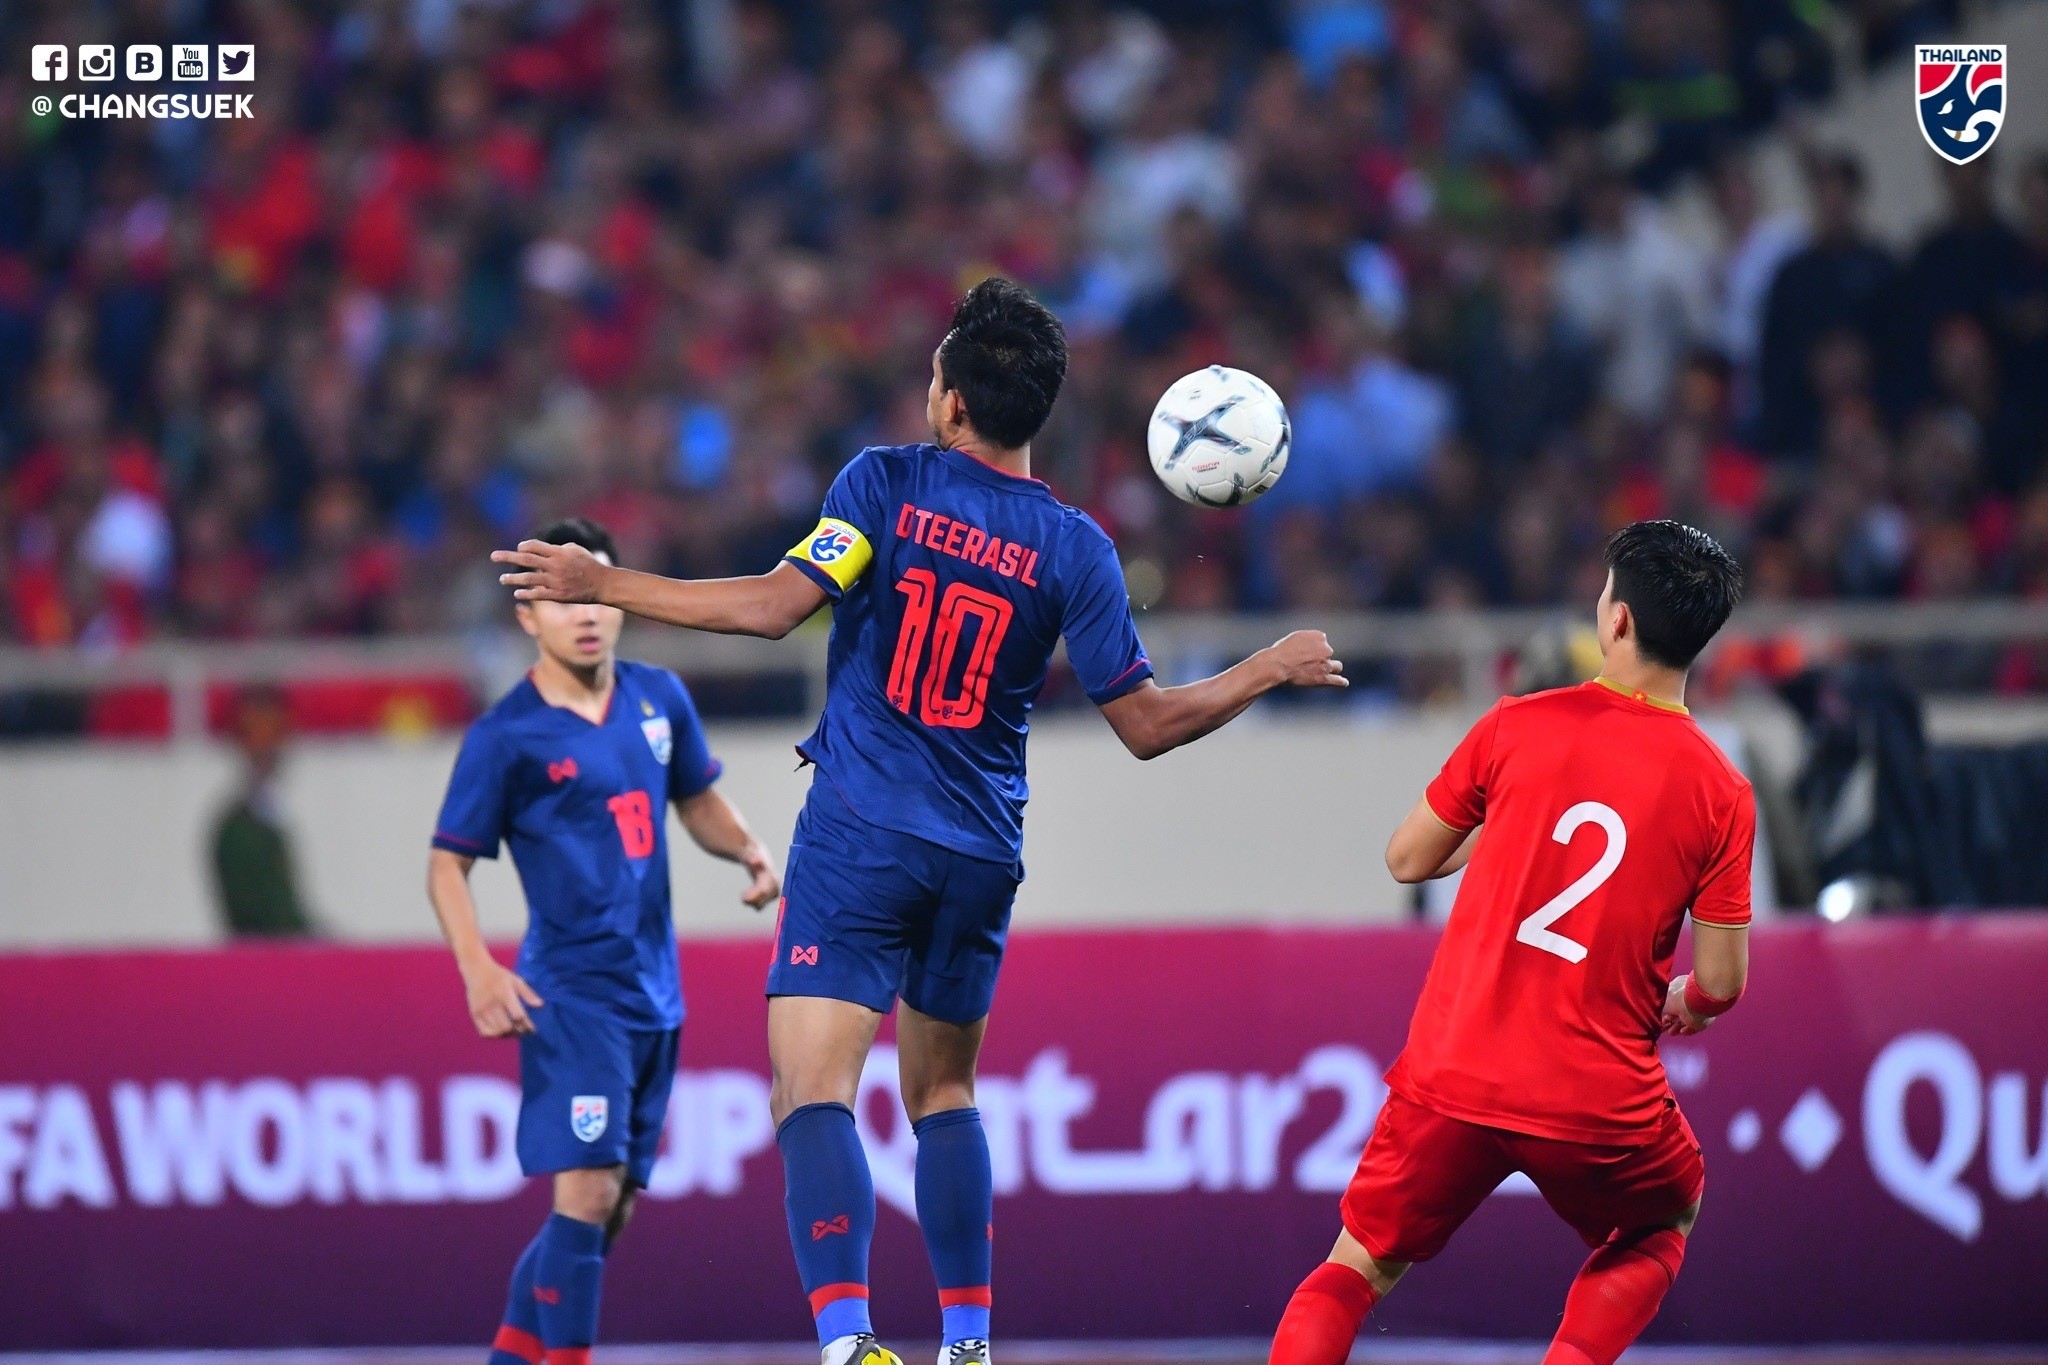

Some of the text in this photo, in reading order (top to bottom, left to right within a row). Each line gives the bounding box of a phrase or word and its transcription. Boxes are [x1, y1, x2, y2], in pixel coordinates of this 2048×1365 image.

[895, 502, 1039, 588] DTEERASIL
[886, 567, 1014, 730] 10
[1515, 800, 1628, 965] 2
[109, 1075, 532, 1208] WORLD
